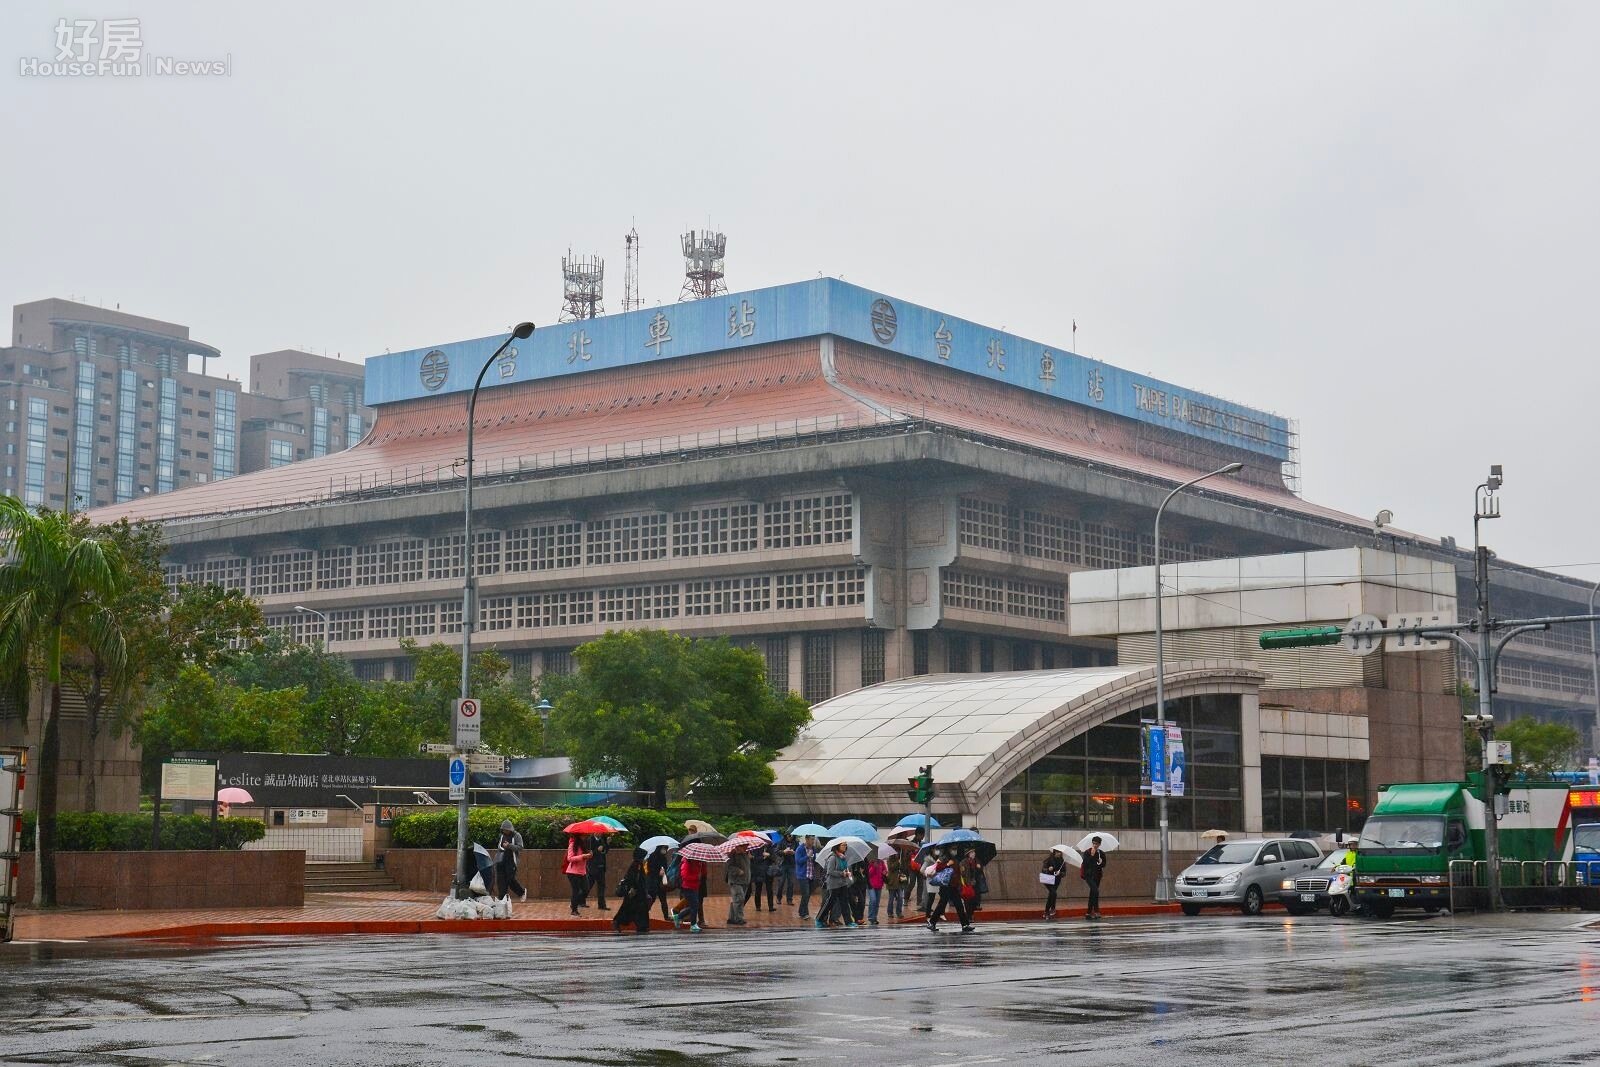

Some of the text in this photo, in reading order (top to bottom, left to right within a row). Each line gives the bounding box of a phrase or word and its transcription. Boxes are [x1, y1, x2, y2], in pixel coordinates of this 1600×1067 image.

[496, 299, 757, 379] 台北車站
[934, 318, 1105, 402] 台北車站
[1132, 383, 1169, 417] TAIPEI
[229, 772, 262, 786] eslite
[264, 773, 319, 788] 誠品站前店
